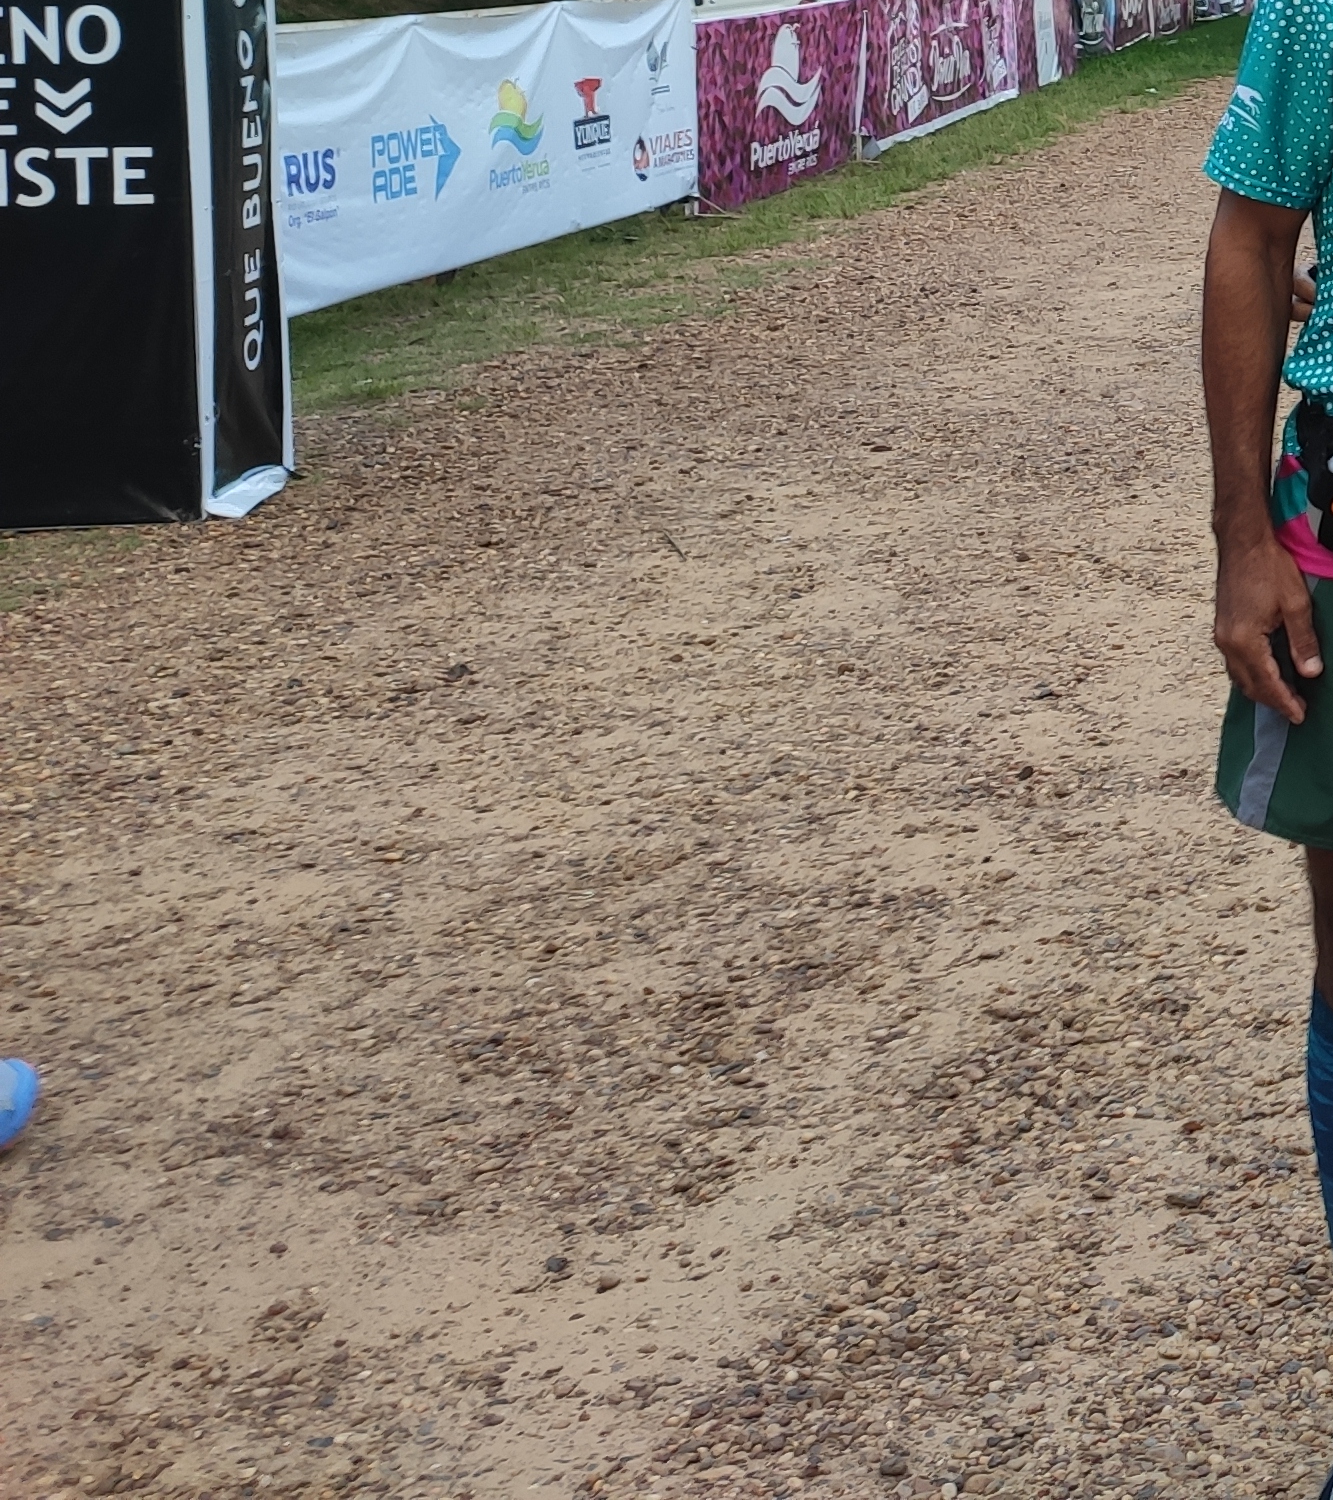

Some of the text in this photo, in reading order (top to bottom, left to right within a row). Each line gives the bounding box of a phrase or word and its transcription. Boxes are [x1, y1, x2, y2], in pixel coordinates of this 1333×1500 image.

[235, 28, 262, 228] BUENO
[371, 123, 449, 169] POWER
[575, 121, 611, 147] YUNQUE
[649, 129, 693, 156] VIAJES
[283, 148, 336, 197] RUS
[372, 163, 418, 204] ADE
[241, 247, 265, 372] QUE
